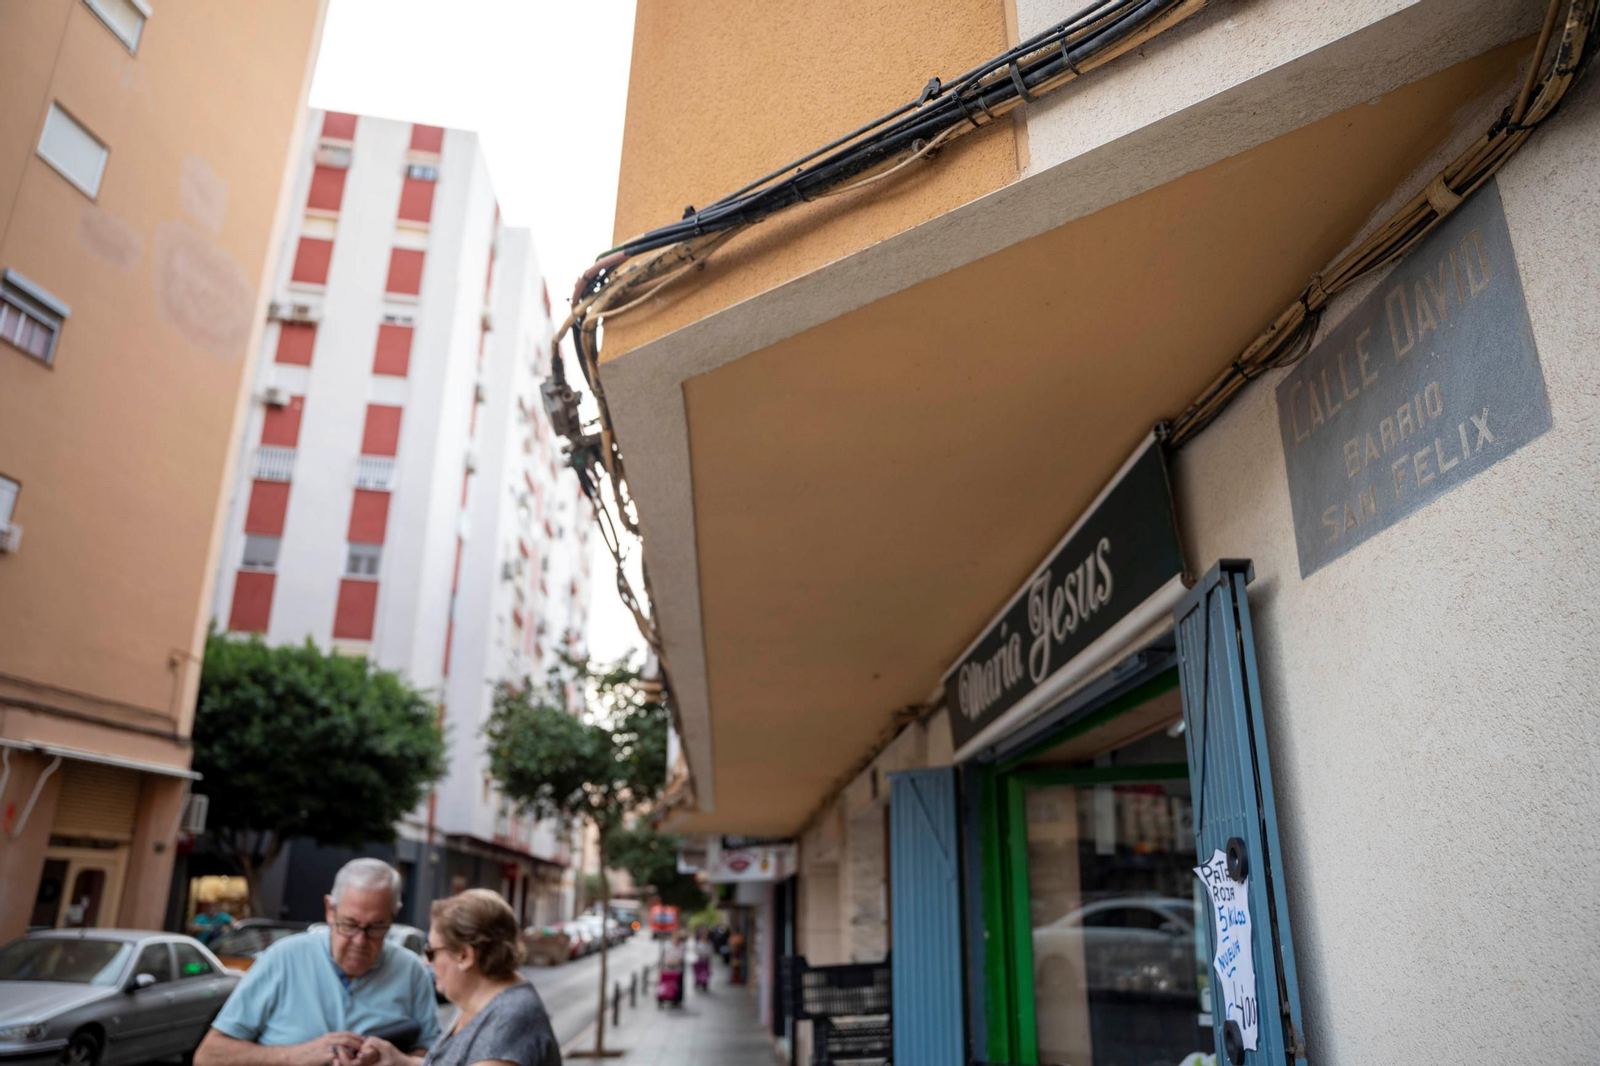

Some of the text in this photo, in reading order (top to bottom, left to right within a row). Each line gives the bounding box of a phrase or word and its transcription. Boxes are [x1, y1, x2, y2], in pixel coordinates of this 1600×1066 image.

[1289, 228, 1491, 443] CALLE DAVID
[1321, 404, 1497, 547] SAN FELIX
[1343, 380, 1444, 478] BARRIO
[1027, 536, 1111, 685] Jesus
